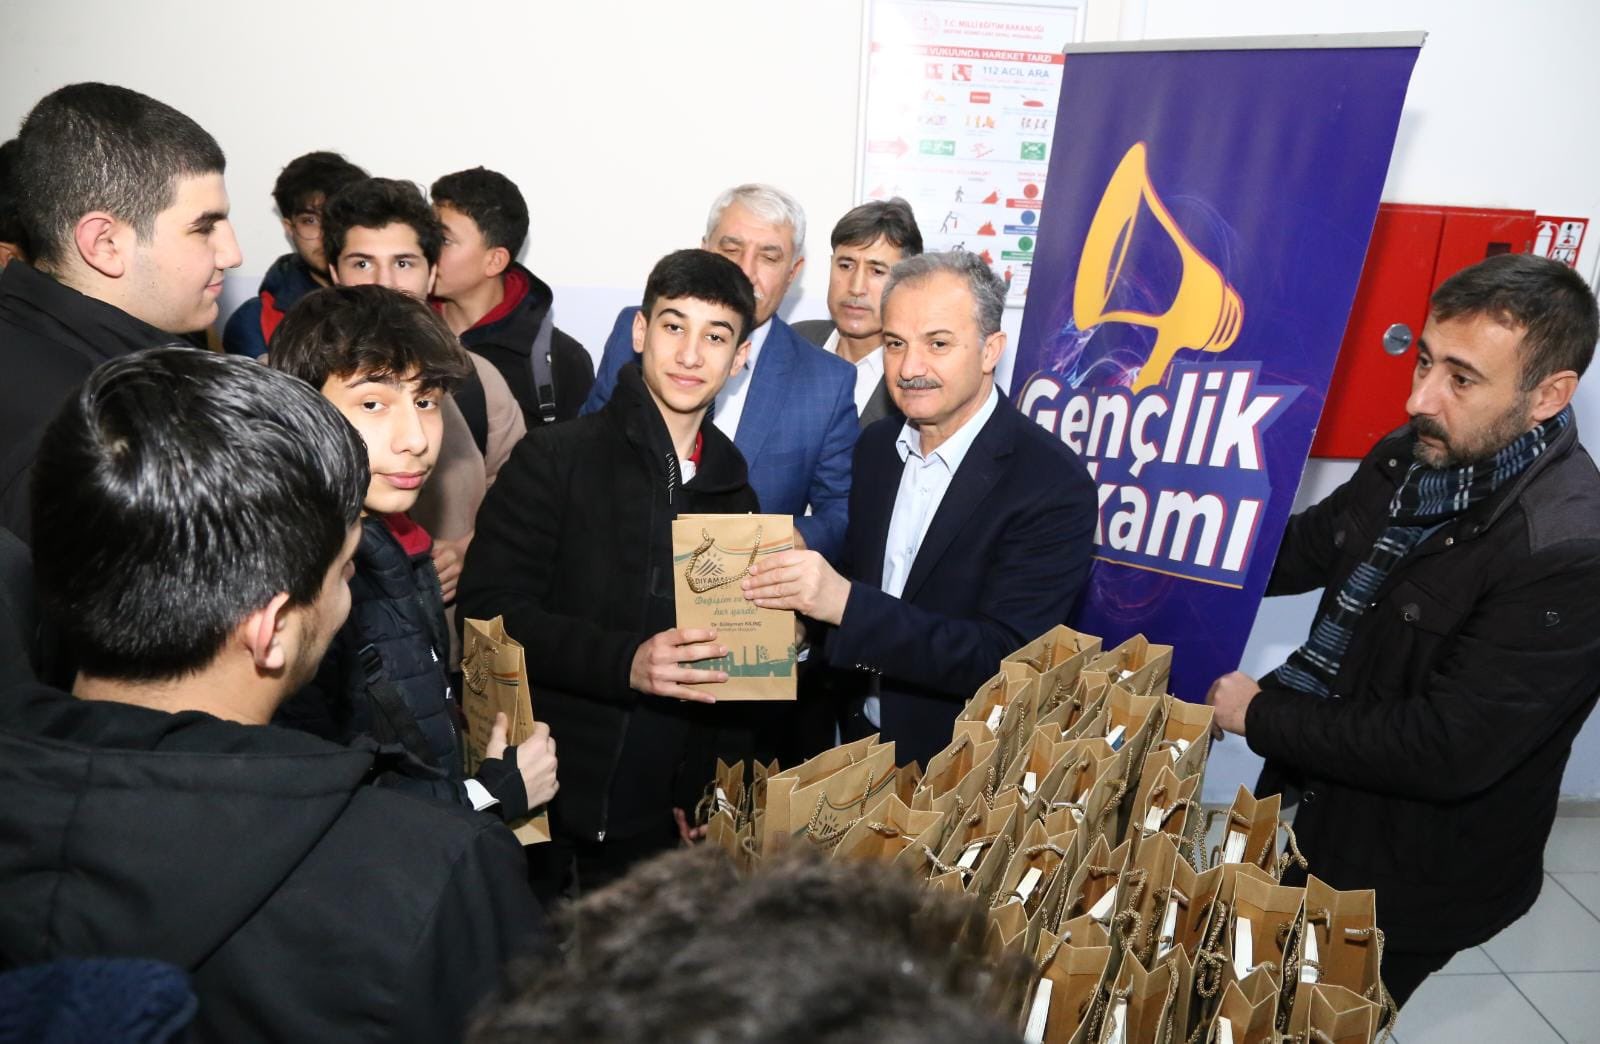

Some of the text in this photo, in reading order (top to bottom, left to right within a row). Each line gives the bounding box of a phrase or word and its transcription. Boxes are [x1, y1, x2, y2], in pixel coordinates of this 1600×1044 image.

[929, 47, 980, 58] VUKUUNDA
[982, 50, 1024, 60] HAREKET
[983, 66, 999, 76] 112
[1028, 69, 1049, 78] ARA
[1020, 371, 1283, 478] Gençlik
[1088, 462, 1263, 573] kamı
